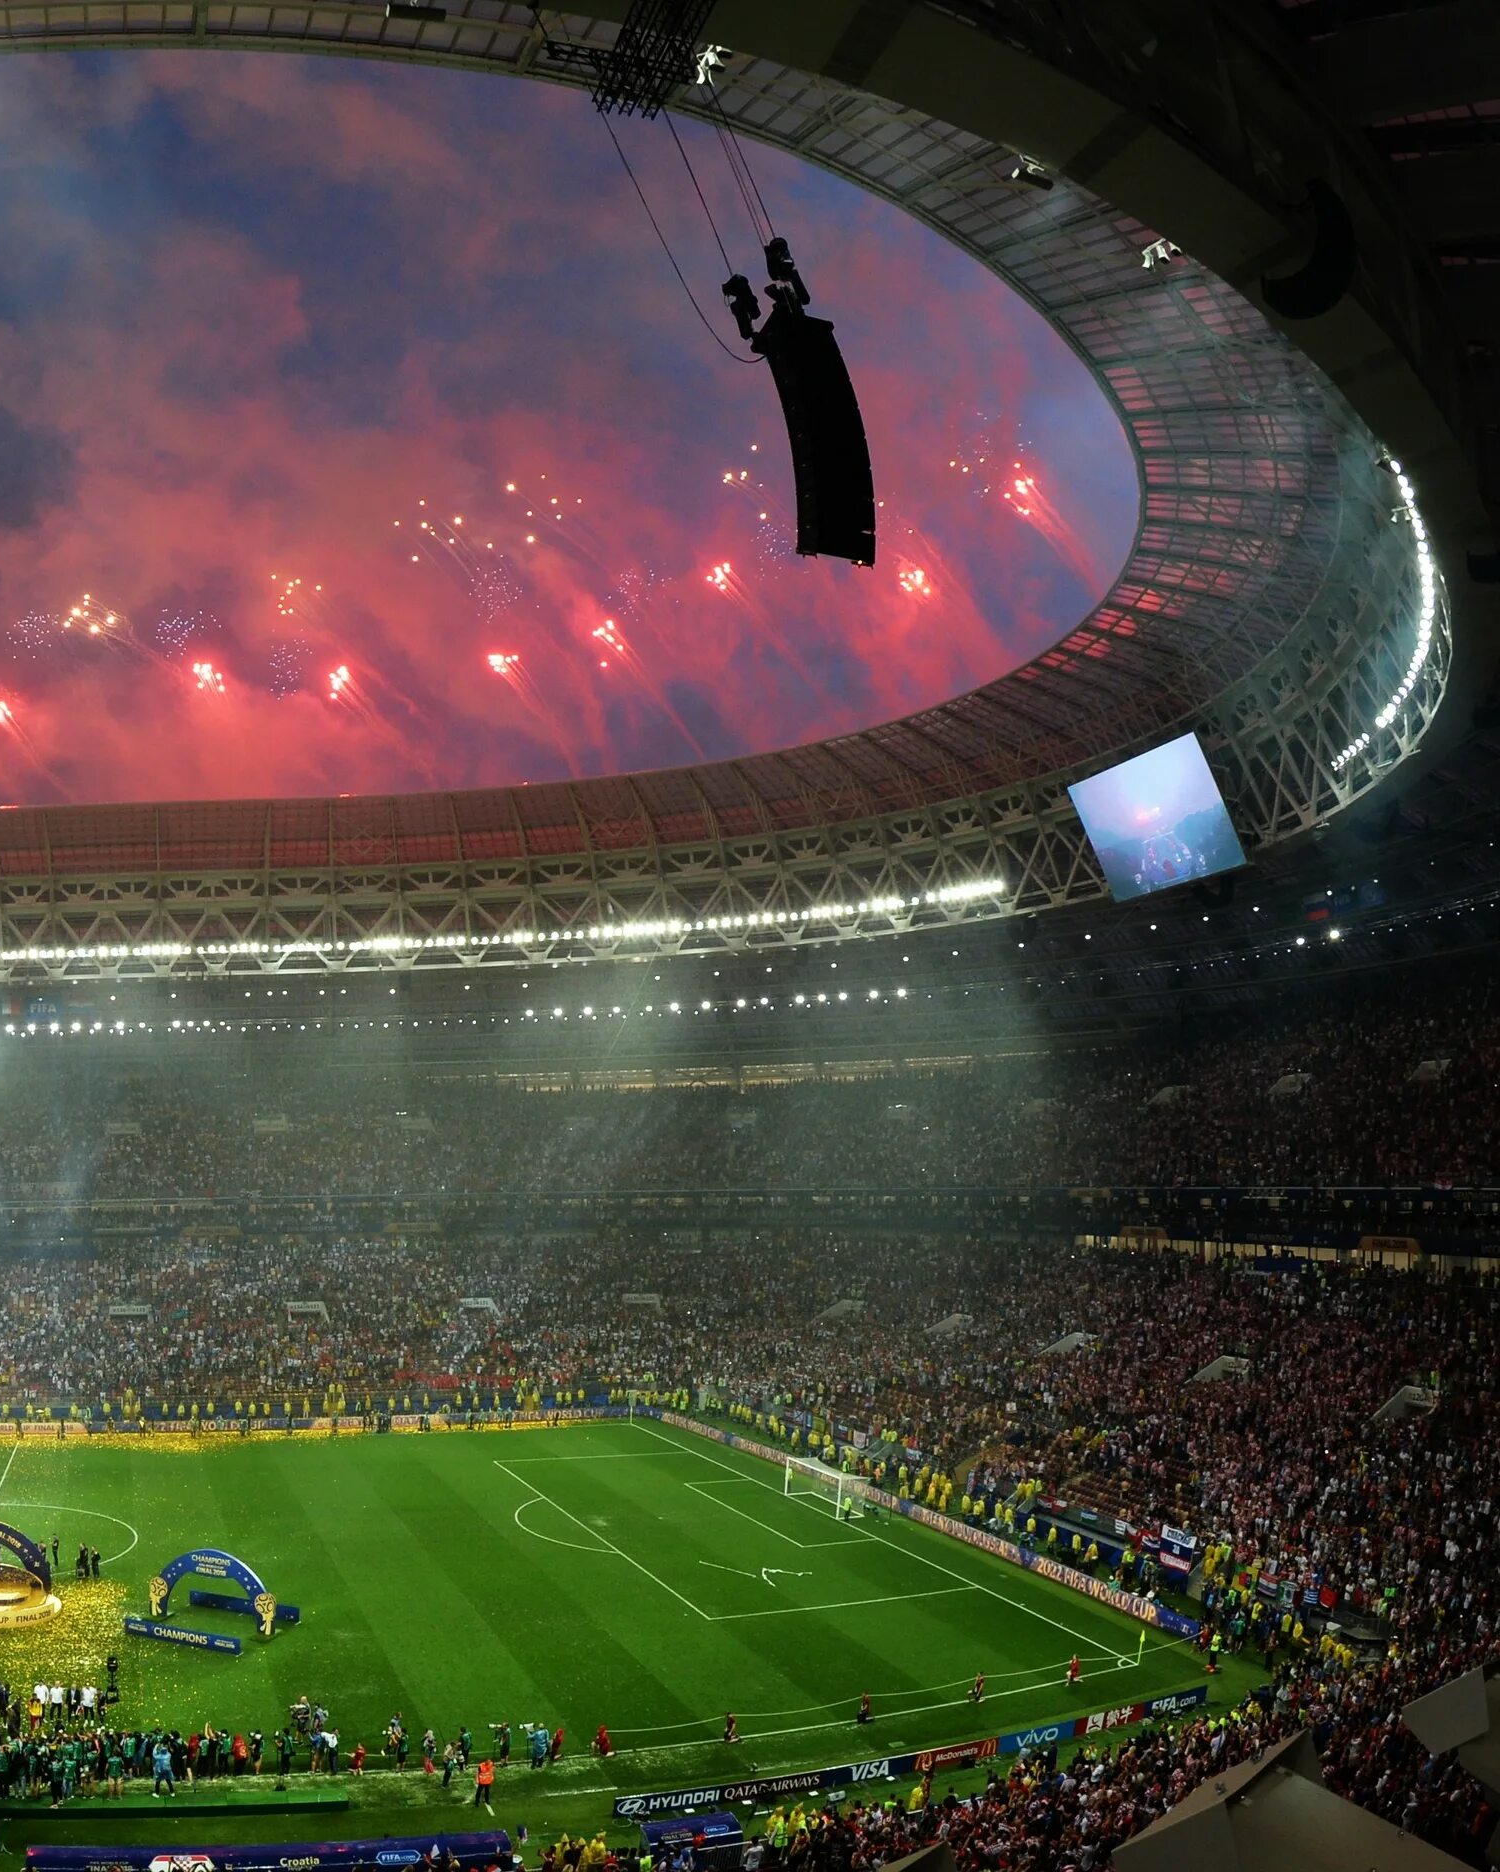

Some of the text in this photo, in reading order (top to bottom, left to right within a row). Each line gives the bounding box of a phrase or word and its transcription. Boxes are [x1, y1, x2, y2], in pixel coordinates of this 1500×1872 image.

[29, 1003, 57, 1013] FIFA
[34, 1424, 56, 1432] FINAL
[6, 1535, 22, 1548] 2018
[191, 1554, 231, 1567] CHAMPIONS
[195, 1566, 213, 1575] FINAL
[1036, 1556, 1062, 1582] 2022
[1085, 1578, 1130, 1611] WORLD
[1131, 1597, 1157, 1622] CUP
[15, 1614, 37, 1624] FINAL
[153, 1626, 209, 1645] CHAMPIONS
[1105, 1704, 1134, 1729] 蒙牛
[935, 1747, 979, 1762] McDonald's
[850, 1760, 889, 1782] VISA
[650, 1789, 720, 1810] HYUNDAI
[768, 1774, 821, 1792] AIRWAYS
[279, 1856, 320, 1868] Croatia
